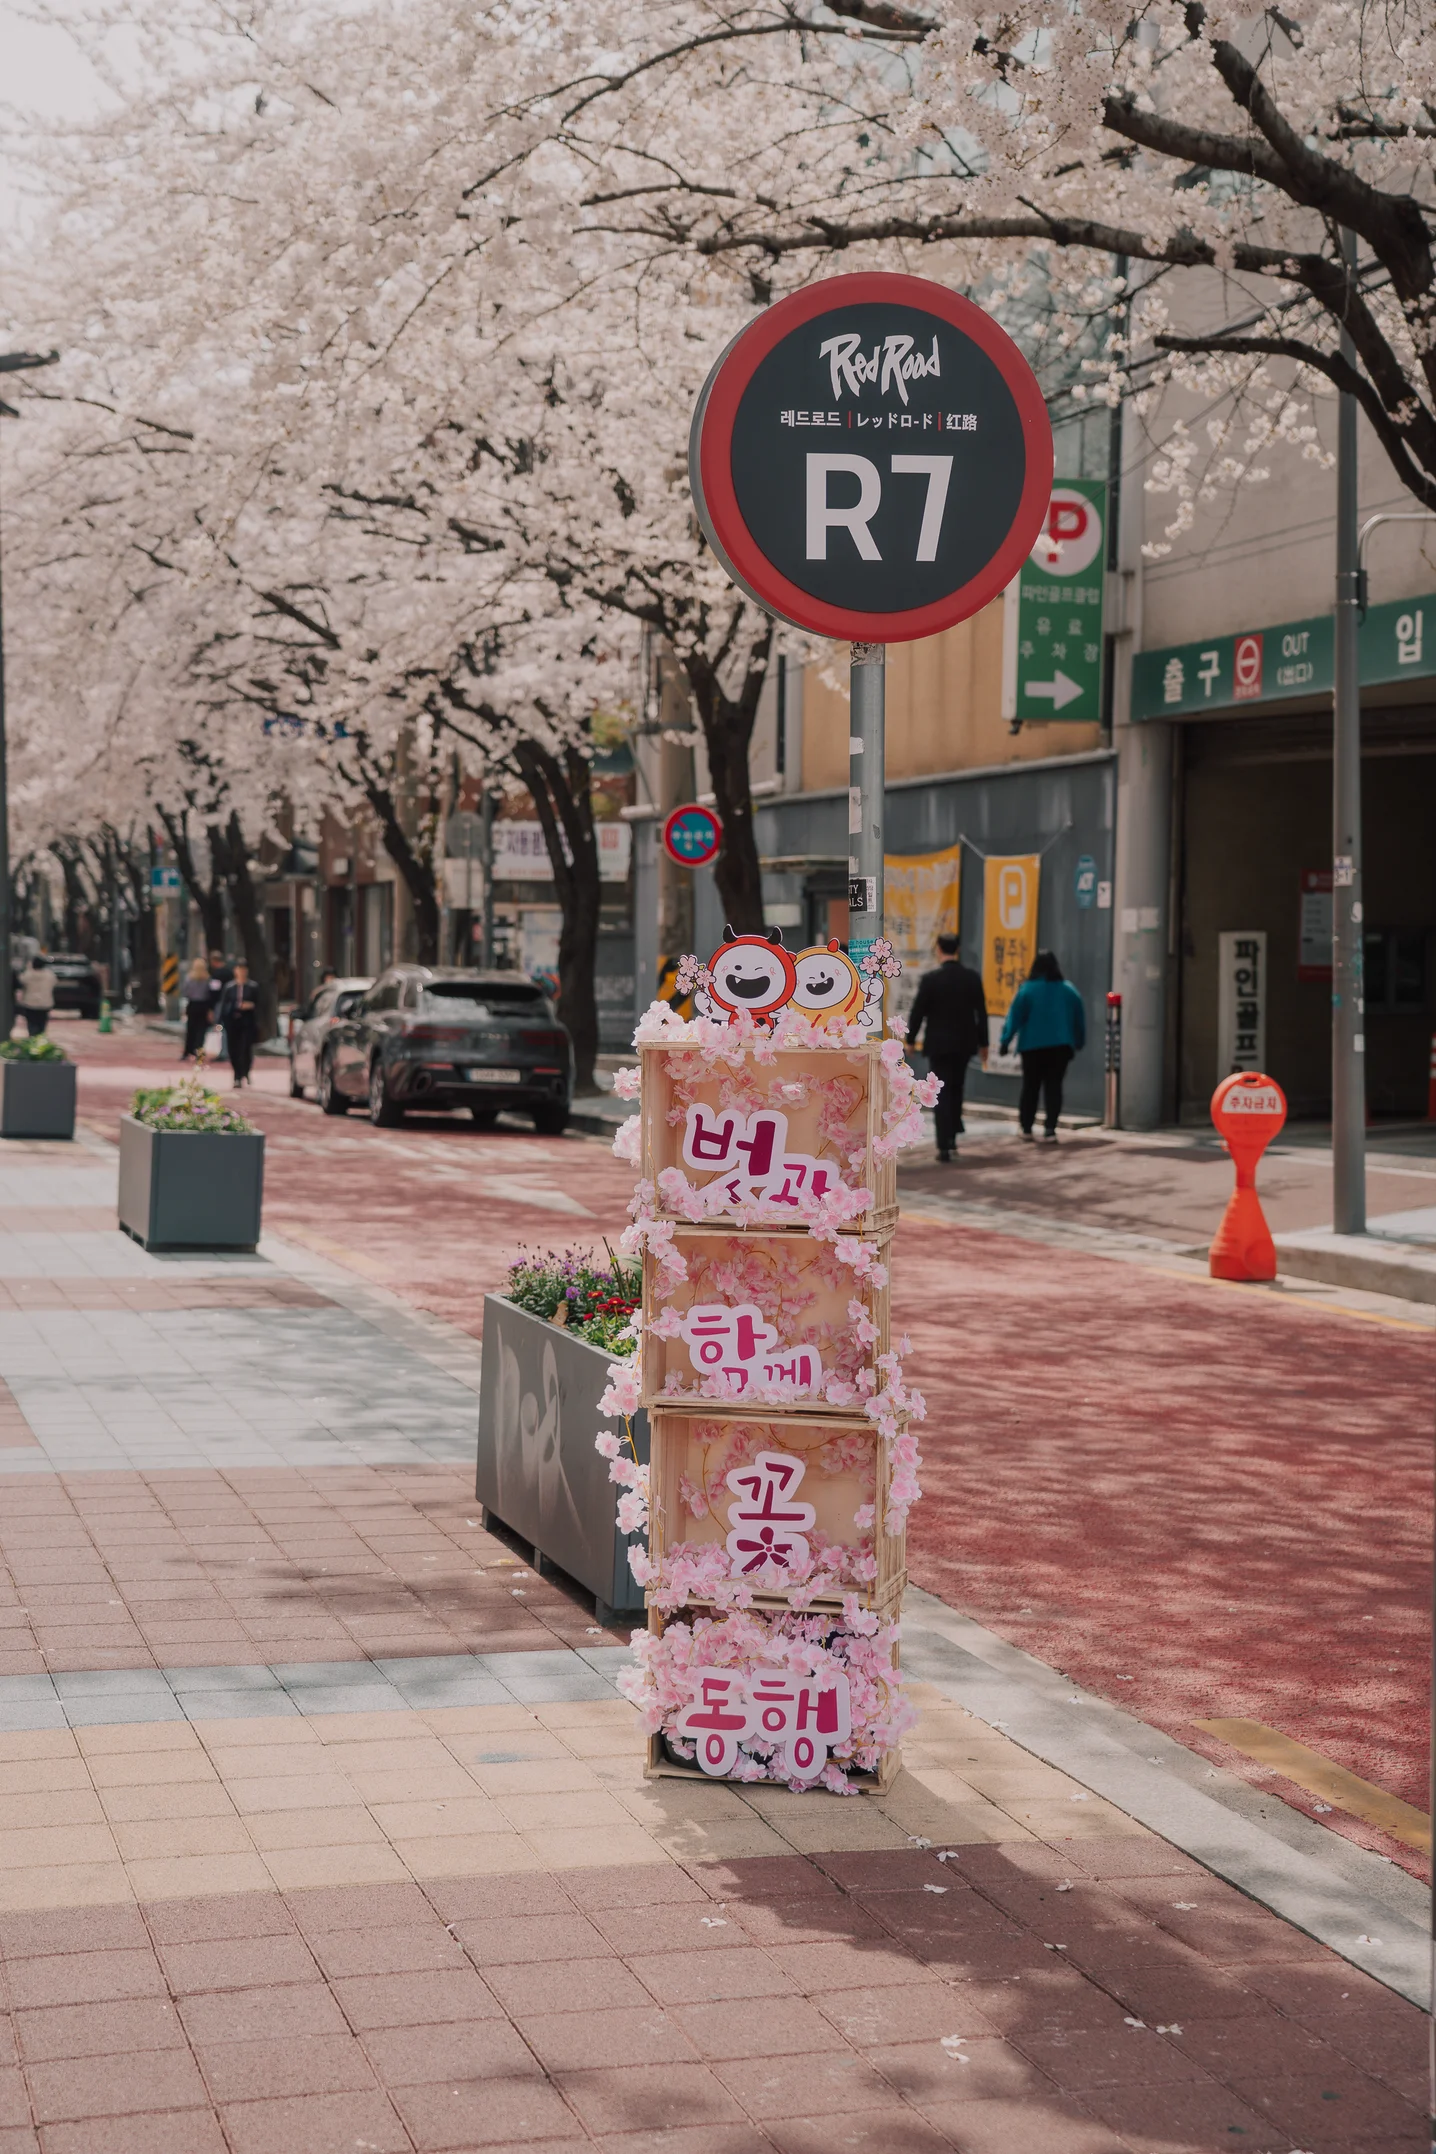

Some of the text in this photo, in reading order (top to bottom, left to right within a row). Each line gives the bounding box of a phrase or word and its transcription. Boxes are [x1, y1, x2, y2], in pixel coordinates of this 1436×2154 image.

[819, 333, 941, 406] Red Road
[780, 410, 842, 427] 레드로드
[946, 413, 978, 431] 红路
[806, 453, 954, 561] R7
[1281, 631, 1311, 657] OUT
[1395, 609, 1424, 665] 입
[1163, 650, 1221, 704] 출구
[685, 1677, 839, 1769] 동행
